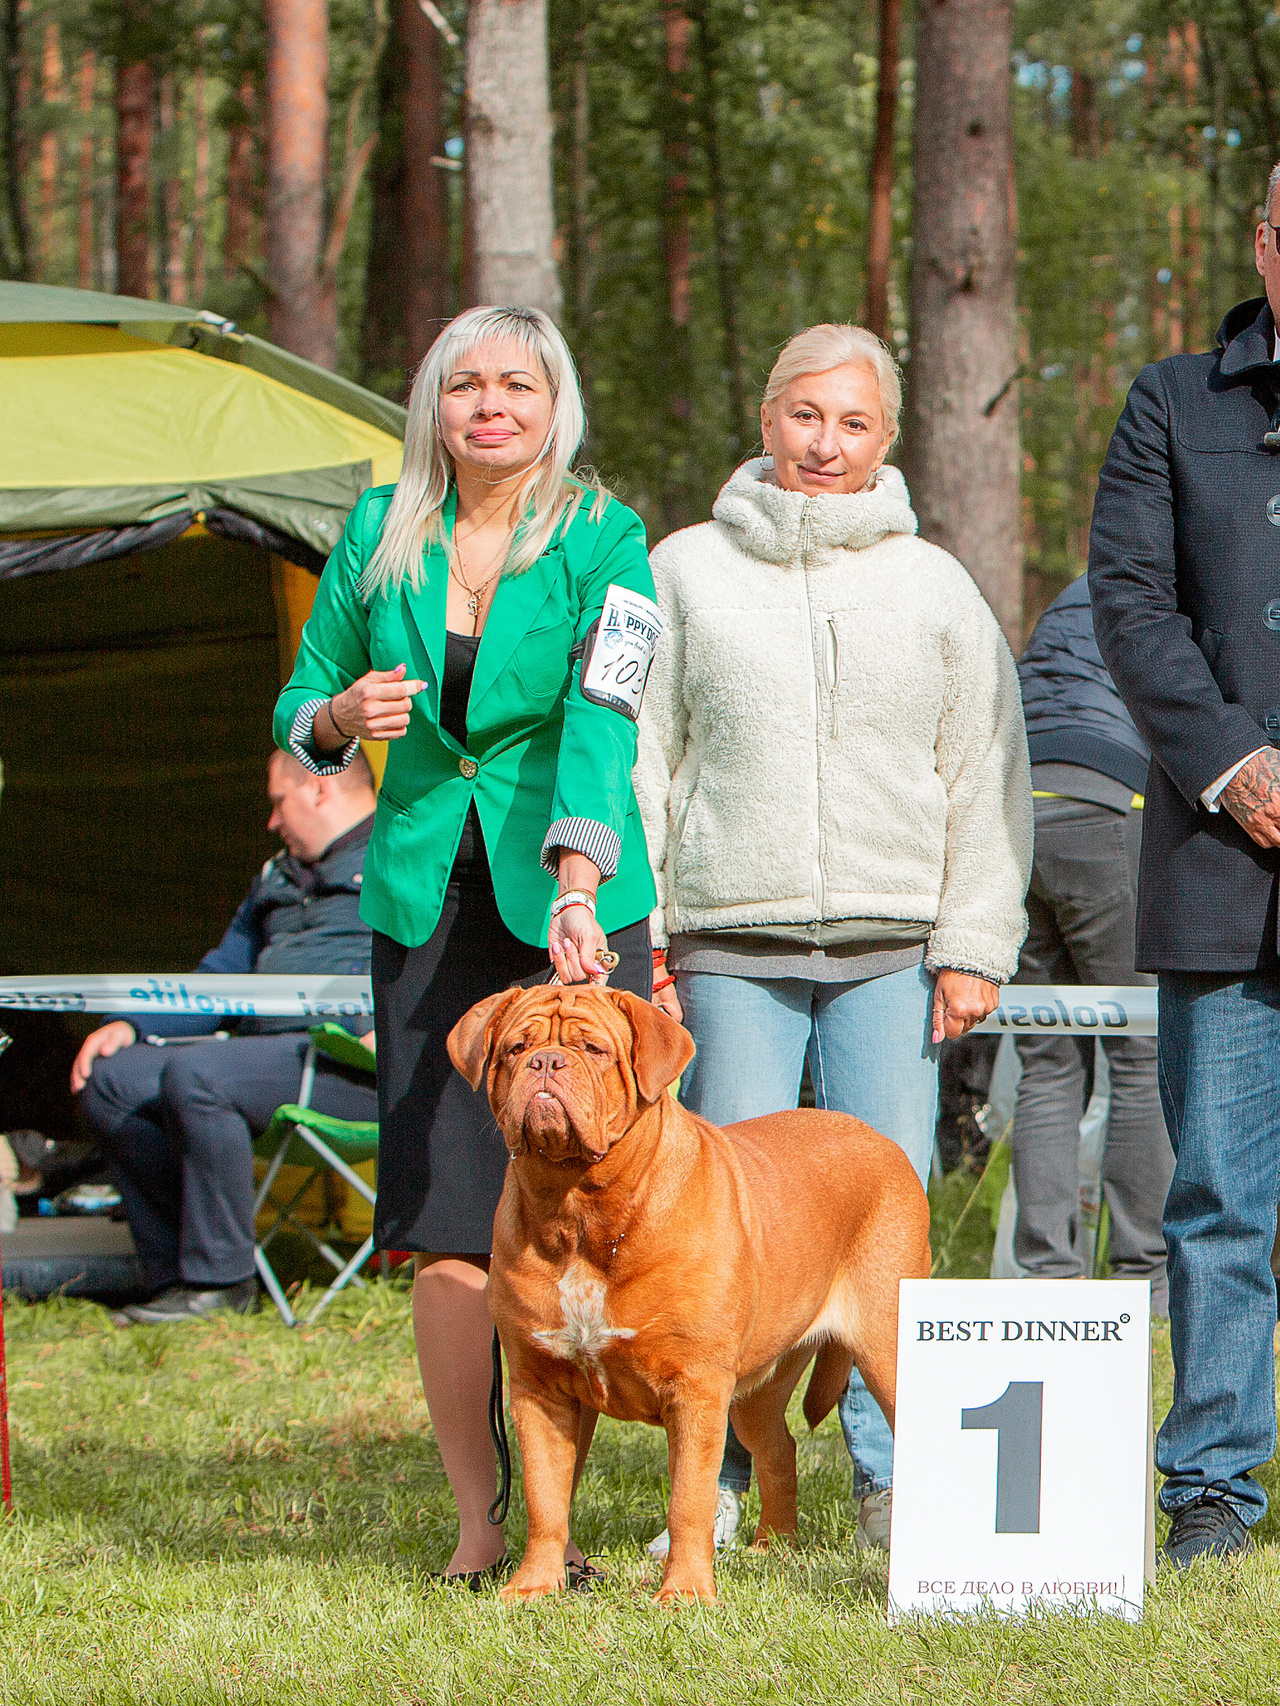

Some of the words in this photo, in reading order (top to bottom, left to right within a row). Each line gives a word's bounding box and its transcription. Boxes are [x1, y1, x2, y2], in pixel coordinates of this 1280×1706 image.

[606, 608, 648, 635] HPPY
[916, 1320, 994, 1342] BEST
[1001, 1320, 1123, 1342] DINNER
[961, 1381, 1044, 1535] 1
[916, 1580, 956, 1594] ВСЕ
[960, 1581, 1015, 1596] ДЕЛО
[1021, 1581, 1034, 1595] В
[1039, 1581, 1118, 1596] ЛЮБВИ!
